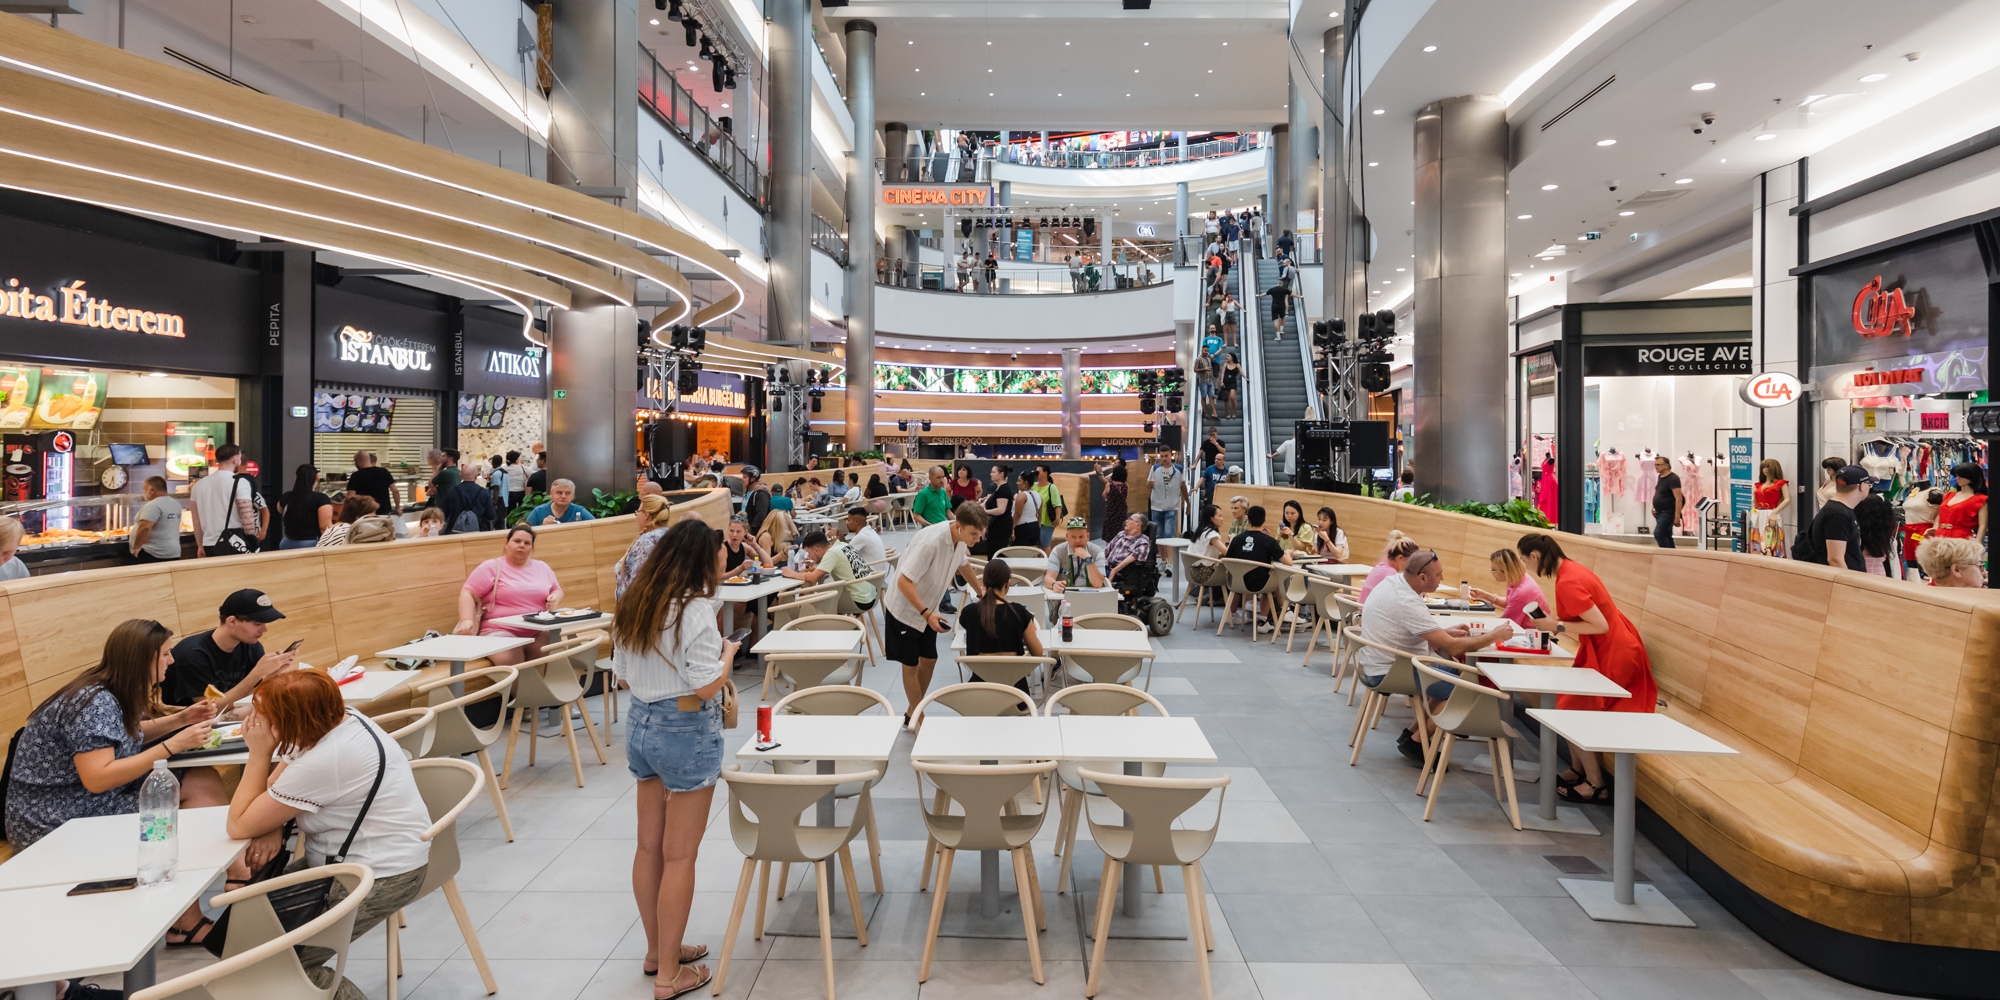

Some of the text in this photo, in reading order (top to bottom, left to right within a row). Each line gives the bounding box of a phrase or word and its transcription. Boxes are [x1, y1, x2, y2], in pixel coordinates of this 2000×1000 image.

[884, 188, 987, 205] CINEMA CITY
[60, 280, 186, 338] Étterem
[269, 302, 280, 346] PEPITA
[454, 330, 463, 376] ISTANBUL
[1638, 346, 1752, 363] ROUGE AVE
[1668, 363, 1752, 371] COLLECTIO
[1880, 368, 1924, 385] DIVAT
[708, 388, 733, 408] BURGER
[734, 392, 746, 410] BAR
[1000, 437, 1043, 445] BELLOZZO
[1101, 438, 1135, 446] BUDDHA
[1731, 445, 1748, 454] FOOD
